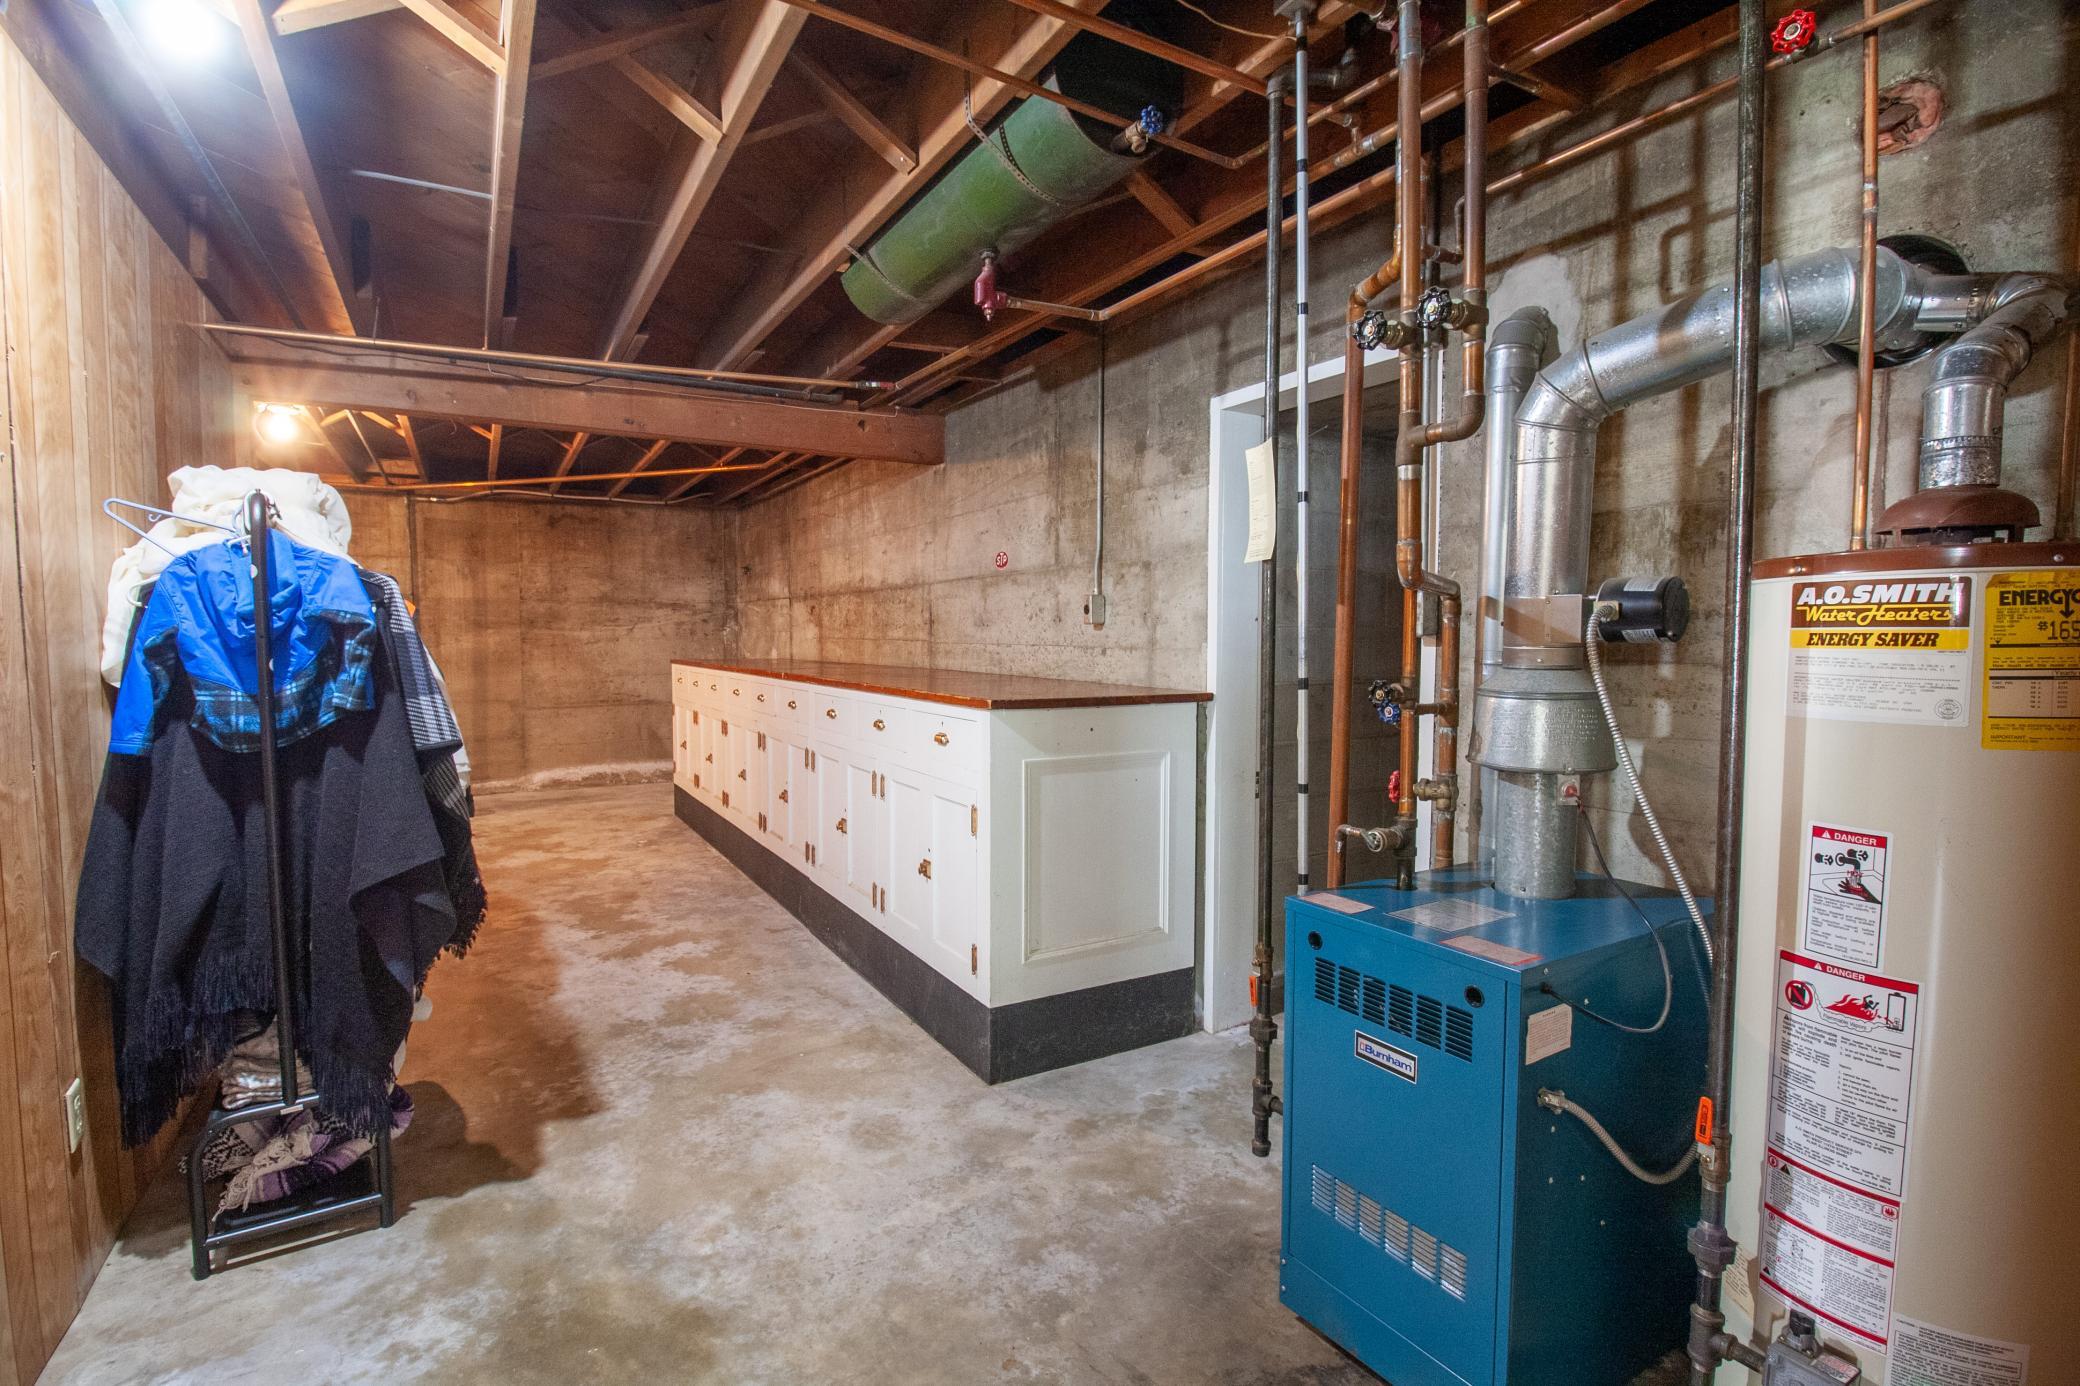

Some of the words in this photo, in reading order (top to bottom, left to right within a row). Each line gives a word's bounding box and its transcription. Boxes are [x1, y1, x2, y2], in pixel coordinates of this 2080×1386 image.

[996, 552, 1007, 566] STP
[1796, 605, 1857, 622] Water
[1856, 604, 1955, 626] Heaters
[1807, 632, 1873, 646] ENERGY
[1874, 632, 1940, 647] SAVER
[1834, 832, 1877, 846] DANGER
[1826, 965, 1866, 982] DANGER
[1364, 1043, 1413, 1073] Burnham
